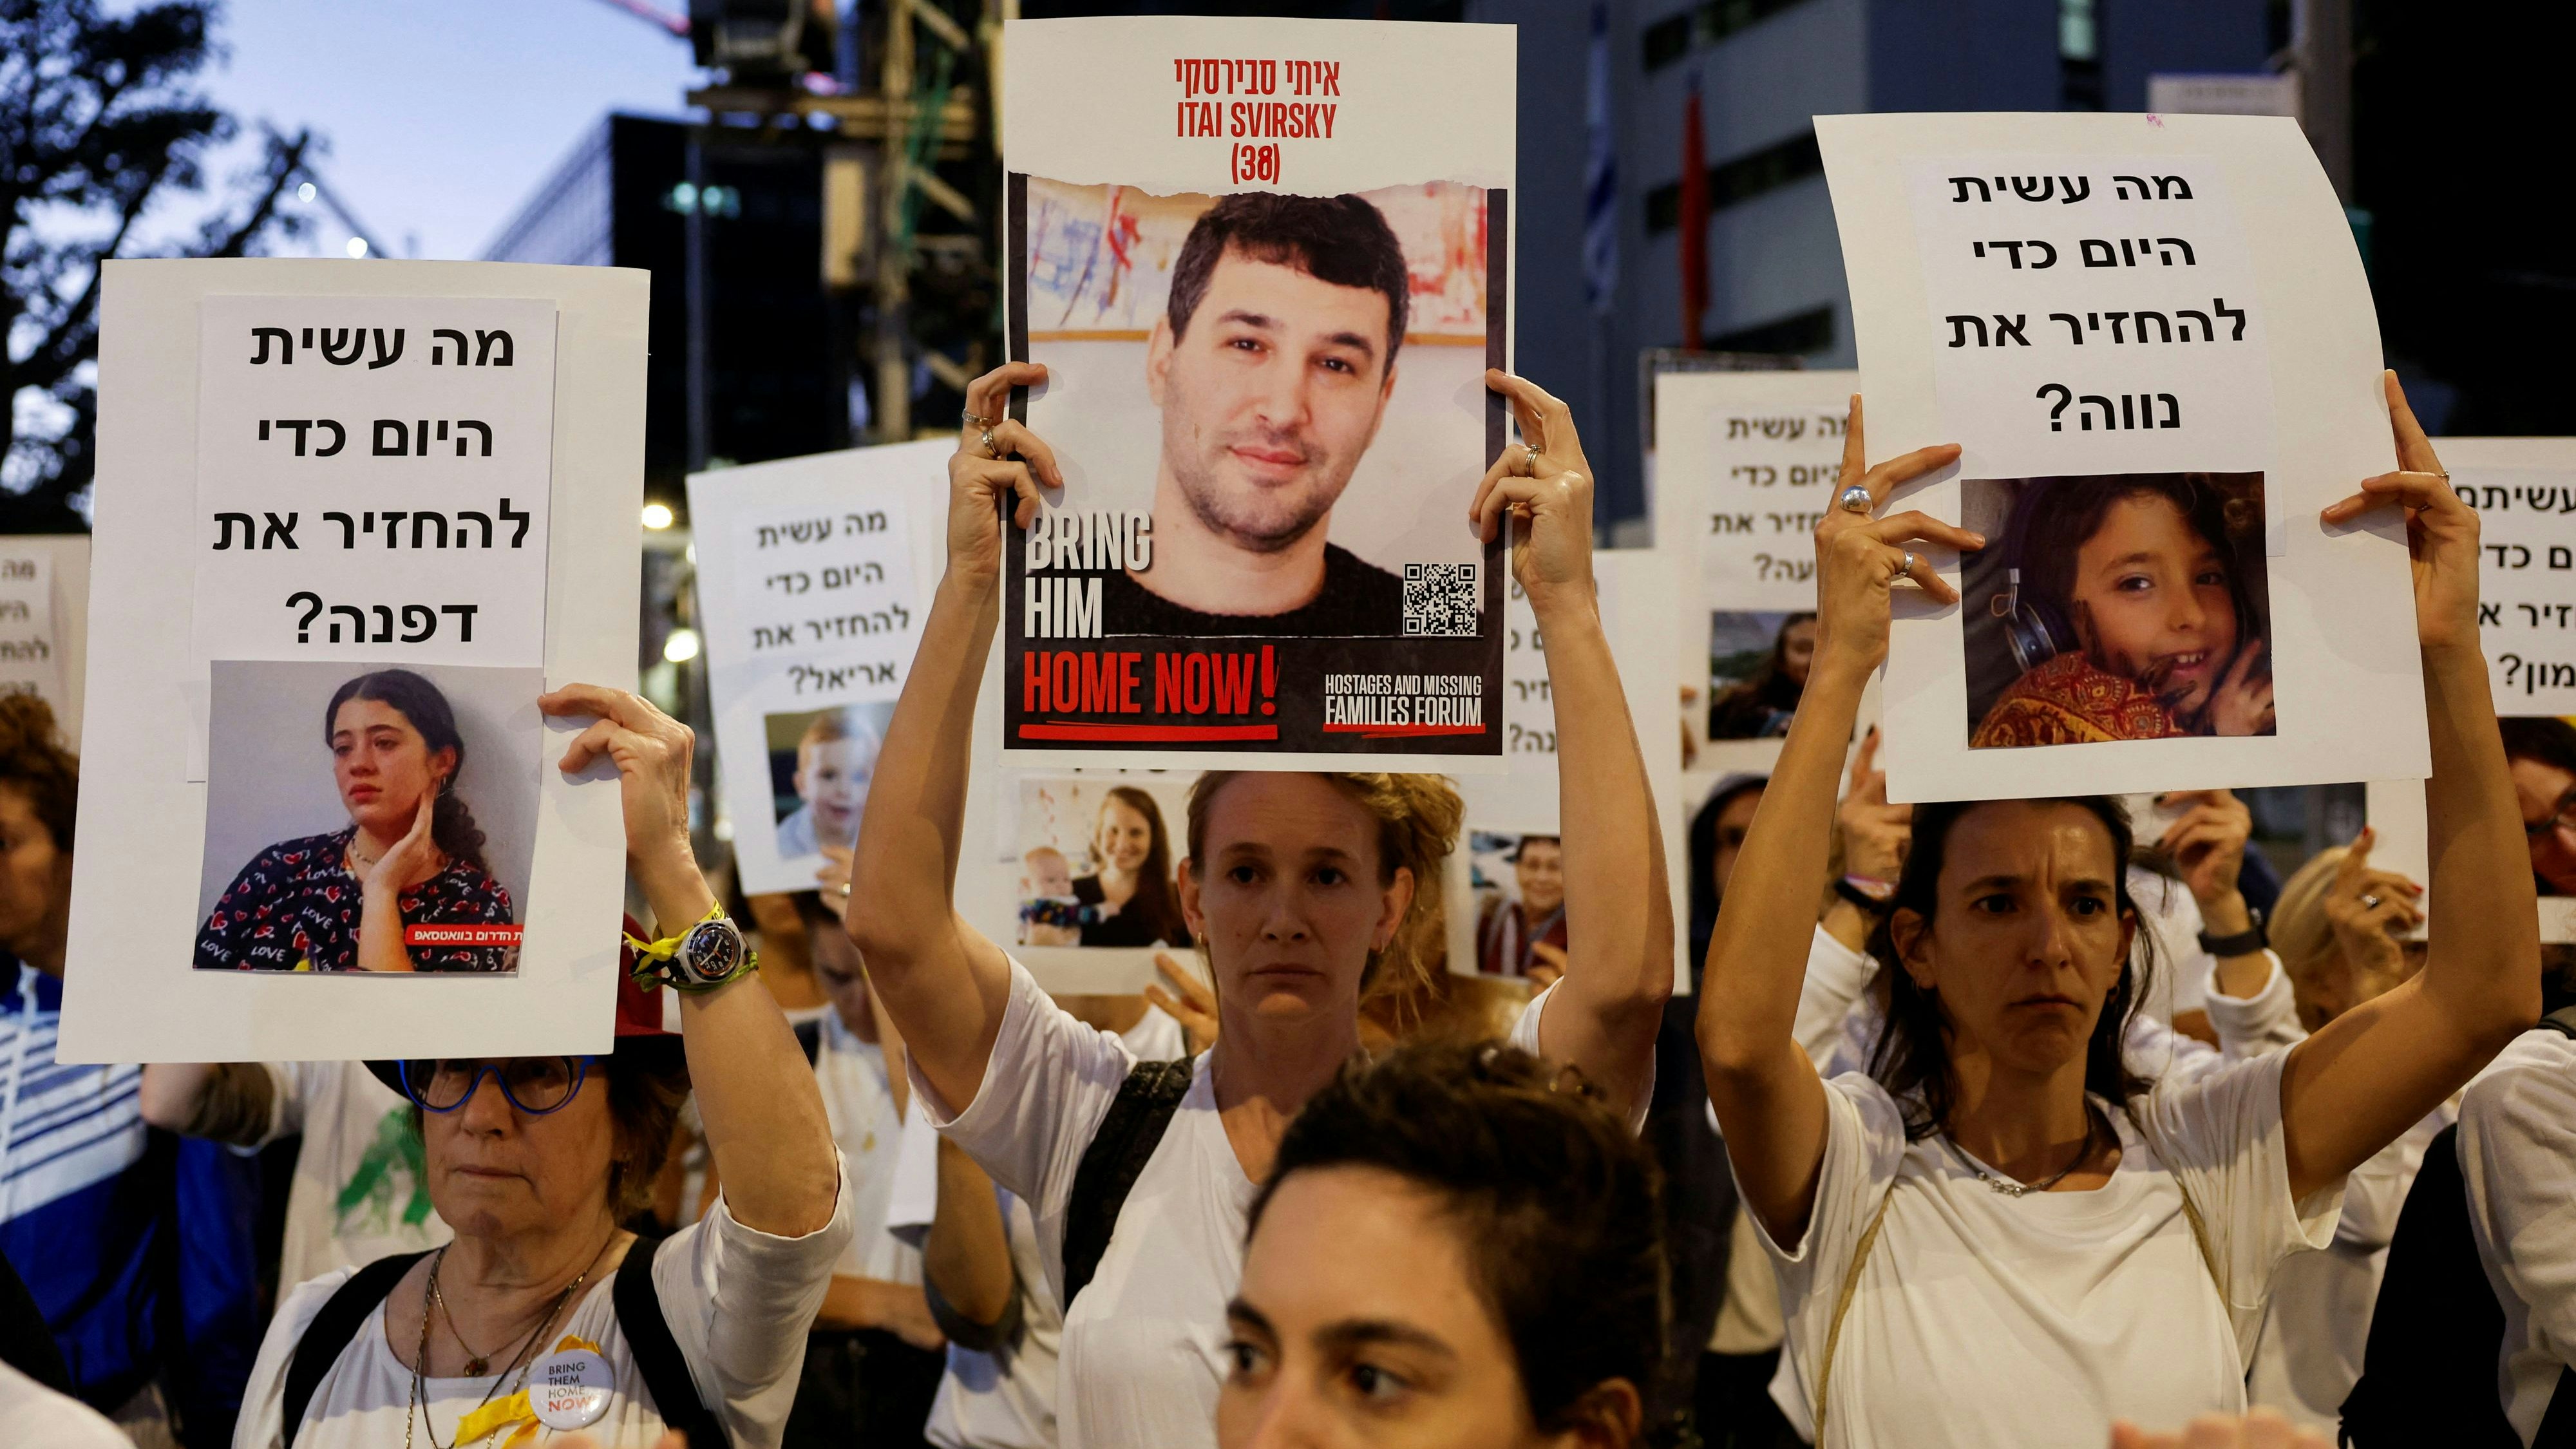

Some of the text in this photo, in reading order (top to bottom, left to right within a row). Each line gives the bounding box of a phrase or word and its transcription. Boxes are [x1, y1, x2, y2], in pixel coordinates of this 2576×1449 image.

[1175, 60, 1340, 98] איתי סבירסקי
[1179, 102, 1336, 137] ITAI SVIRSKY
[1233, 144, 1280, 184] (38)
[1948, 176, 2193, 204] מה עשית
[1973, 238, 2195, 269] היום כדי
[1946, 298, 2246, 347] להחזיר את
[250, 328, 513, 370] מה עשית
[2036, 384, 2180, 431] נווה?
[259, 420, 492, 457] היום כדי
[1728, 419, 1806, 441] עשית
[1731, 466, 1777, 487] כדי
[213, 498, 529, 550] להחזיר את
[757, 511, 887, 548] מה עשית
[1025, 507, 1151, 572] BRING
[1712, 514, 1753, 533] את
[1754, 553, 1814, 583] עה?
[2478, 545, 2531, 569] כד
[766, 562, 884, 594] היום כדי
[286, 592, 477, 643] דפנה?
[1024, 577, 1103, 639] HIM
[753, 603, 910, 649] להחזיר את
[788, 661, 896, 694] אריאל?
[1025, 645, 1275, 715] HOME NOW!
[1326, 674, 1481, 696] HOSTAGES AND MISSING
[2499, 654, 2576, 695] מון?
[1326, 696, 1481, 726] FAMILIES FORUM
[302, 905, 333, 929] LOVE
[201, 939, 232, 962] LOVE
[251, 944, 287, 963] LOVE
[549, 1362, 585, 1374] BRING
[549, 1375, 580, 1385] THEM
[548, 1385, 585, 1399] HOME
